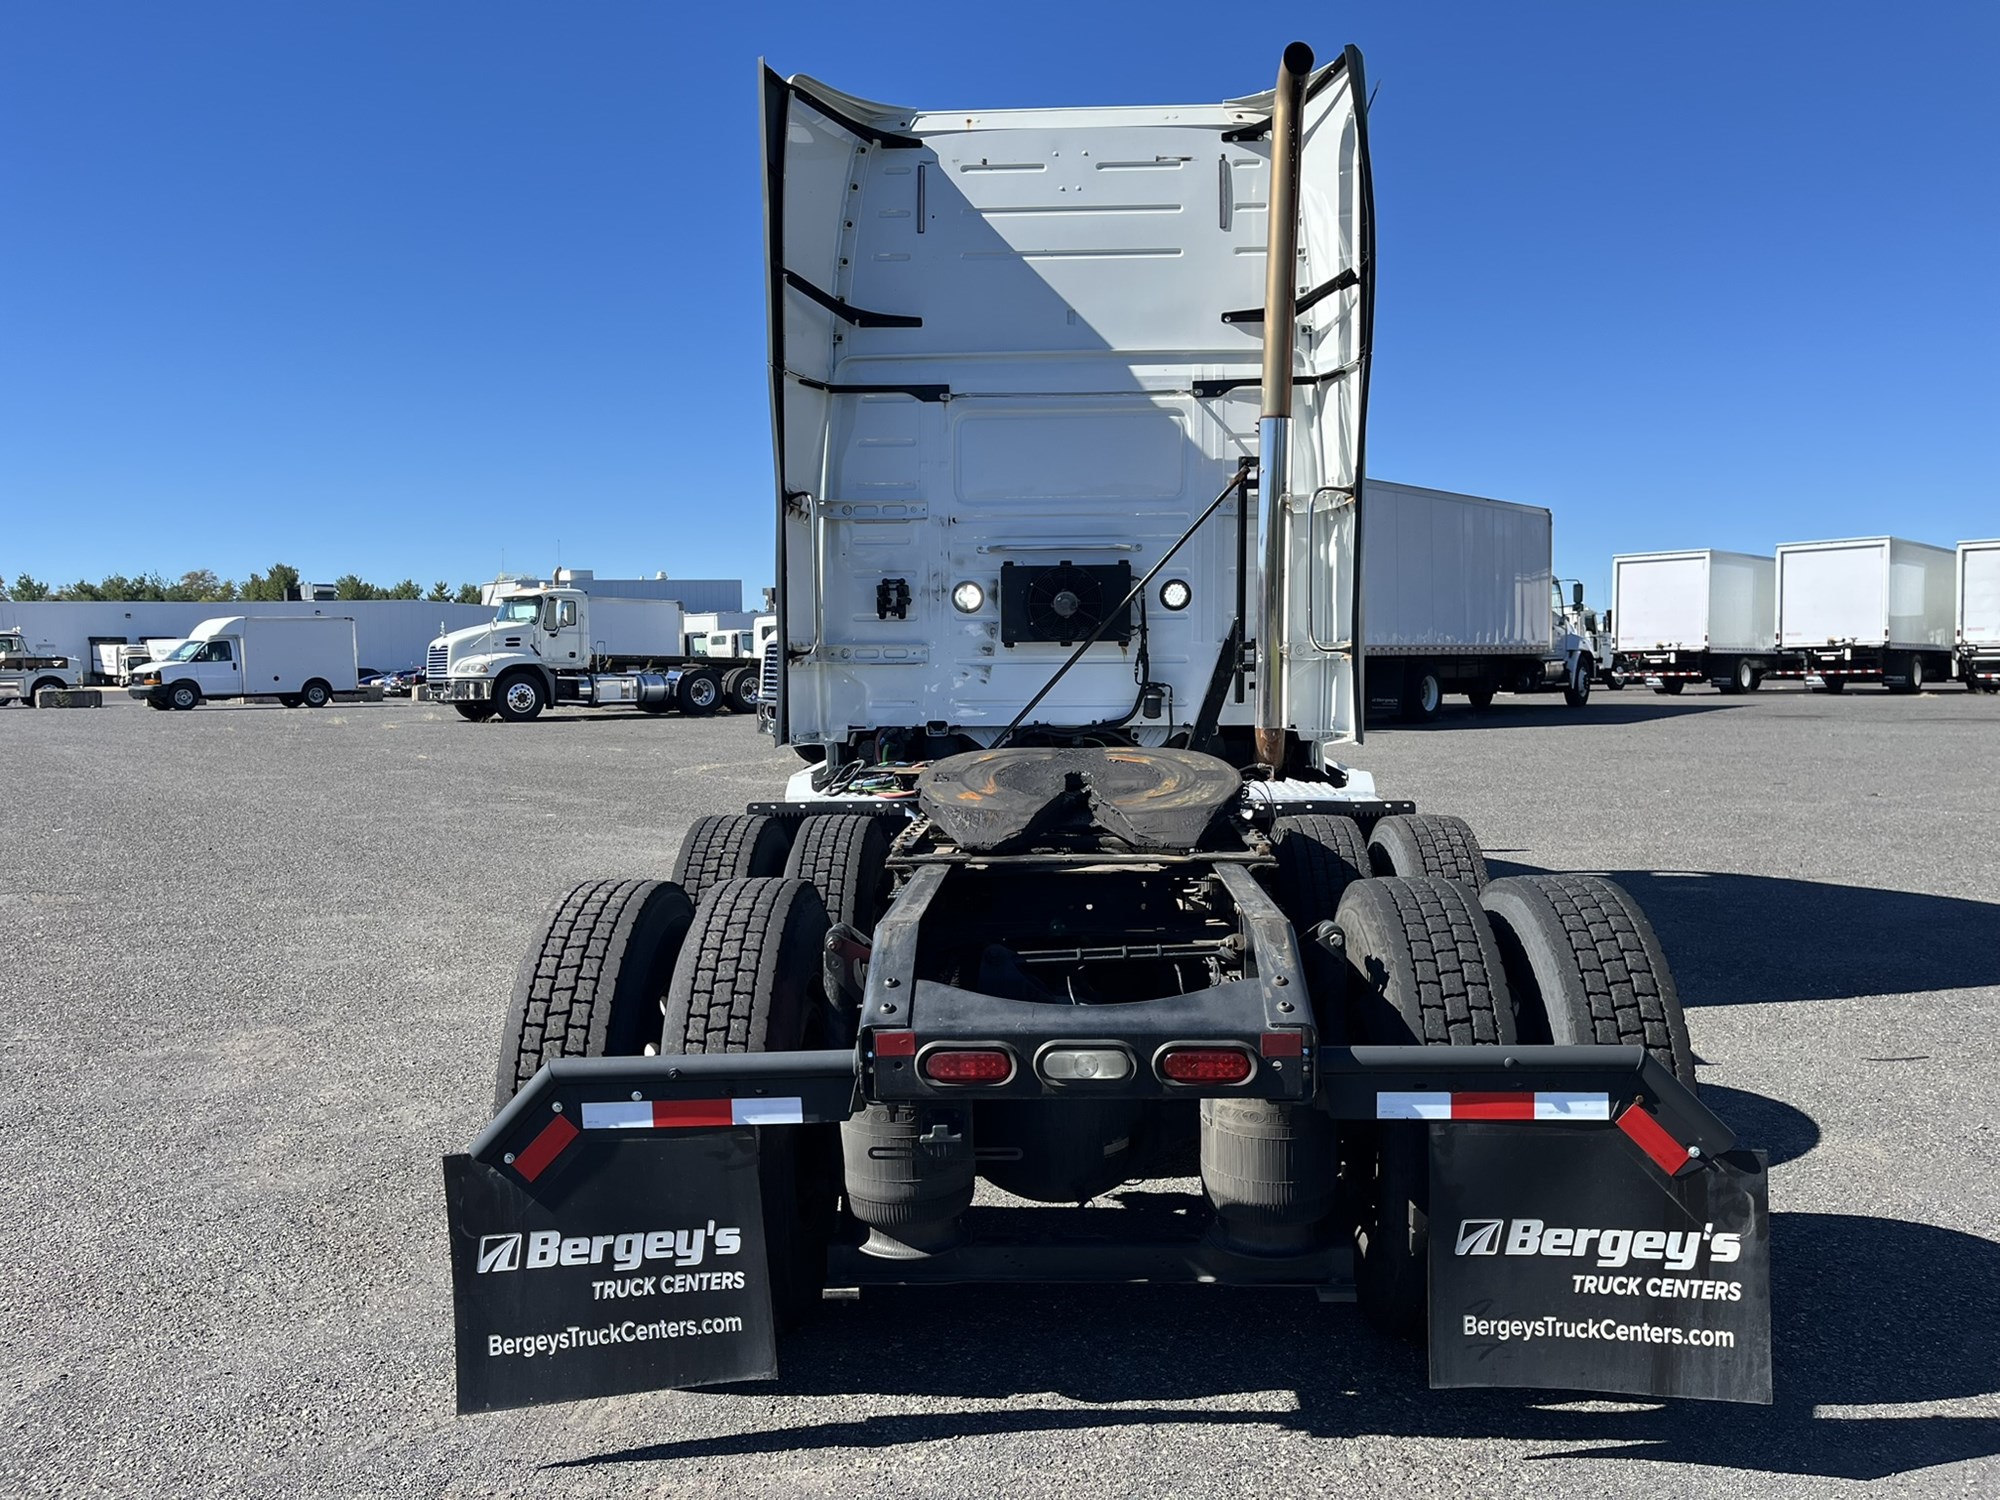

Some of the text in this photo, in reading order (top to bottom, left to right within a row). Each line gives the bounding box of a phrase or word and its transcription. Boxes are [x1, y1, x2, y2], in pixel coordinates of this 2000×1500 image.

[525, 1219, 742, 1272] Bergey's
[1504, 1218, 1742, 1271] Bergey's
[591, 1270, 745, 1300] TRUCK CENTERS
[1572, 1274, 1743, 1302] TRUCK CENTERS
[488, 1316, 743, 1357] BergeysTruckCenters.com
[1463, 1315, 1735, 1348] BergeysTruckCenters.com
